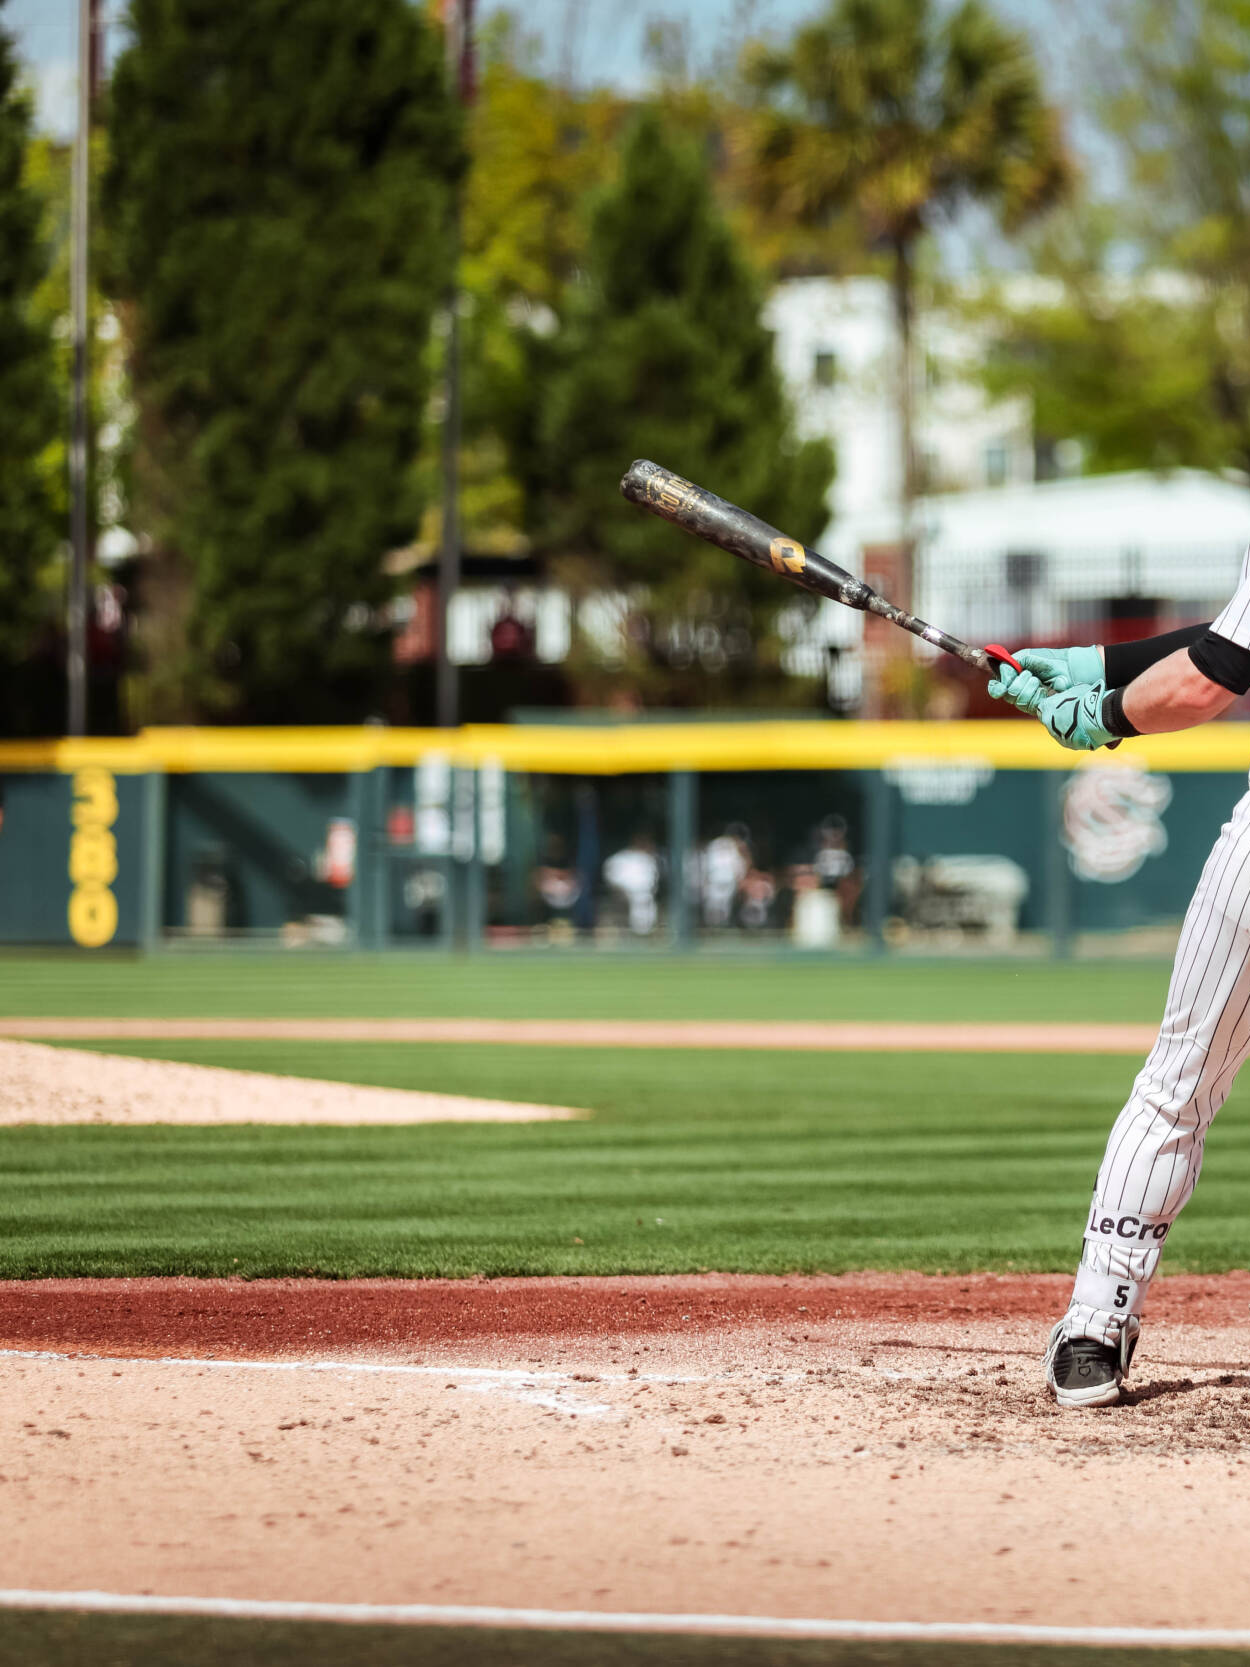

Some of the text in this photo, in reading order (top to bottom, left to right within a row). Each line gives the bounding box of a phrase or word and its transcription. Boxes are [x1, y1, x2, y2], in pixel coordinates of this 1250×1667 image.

[69, 769, 120, 948] 380
[1089, 1208, 1172, 1241] LeCro
[1113, 1285, 1130, 1308] 5
